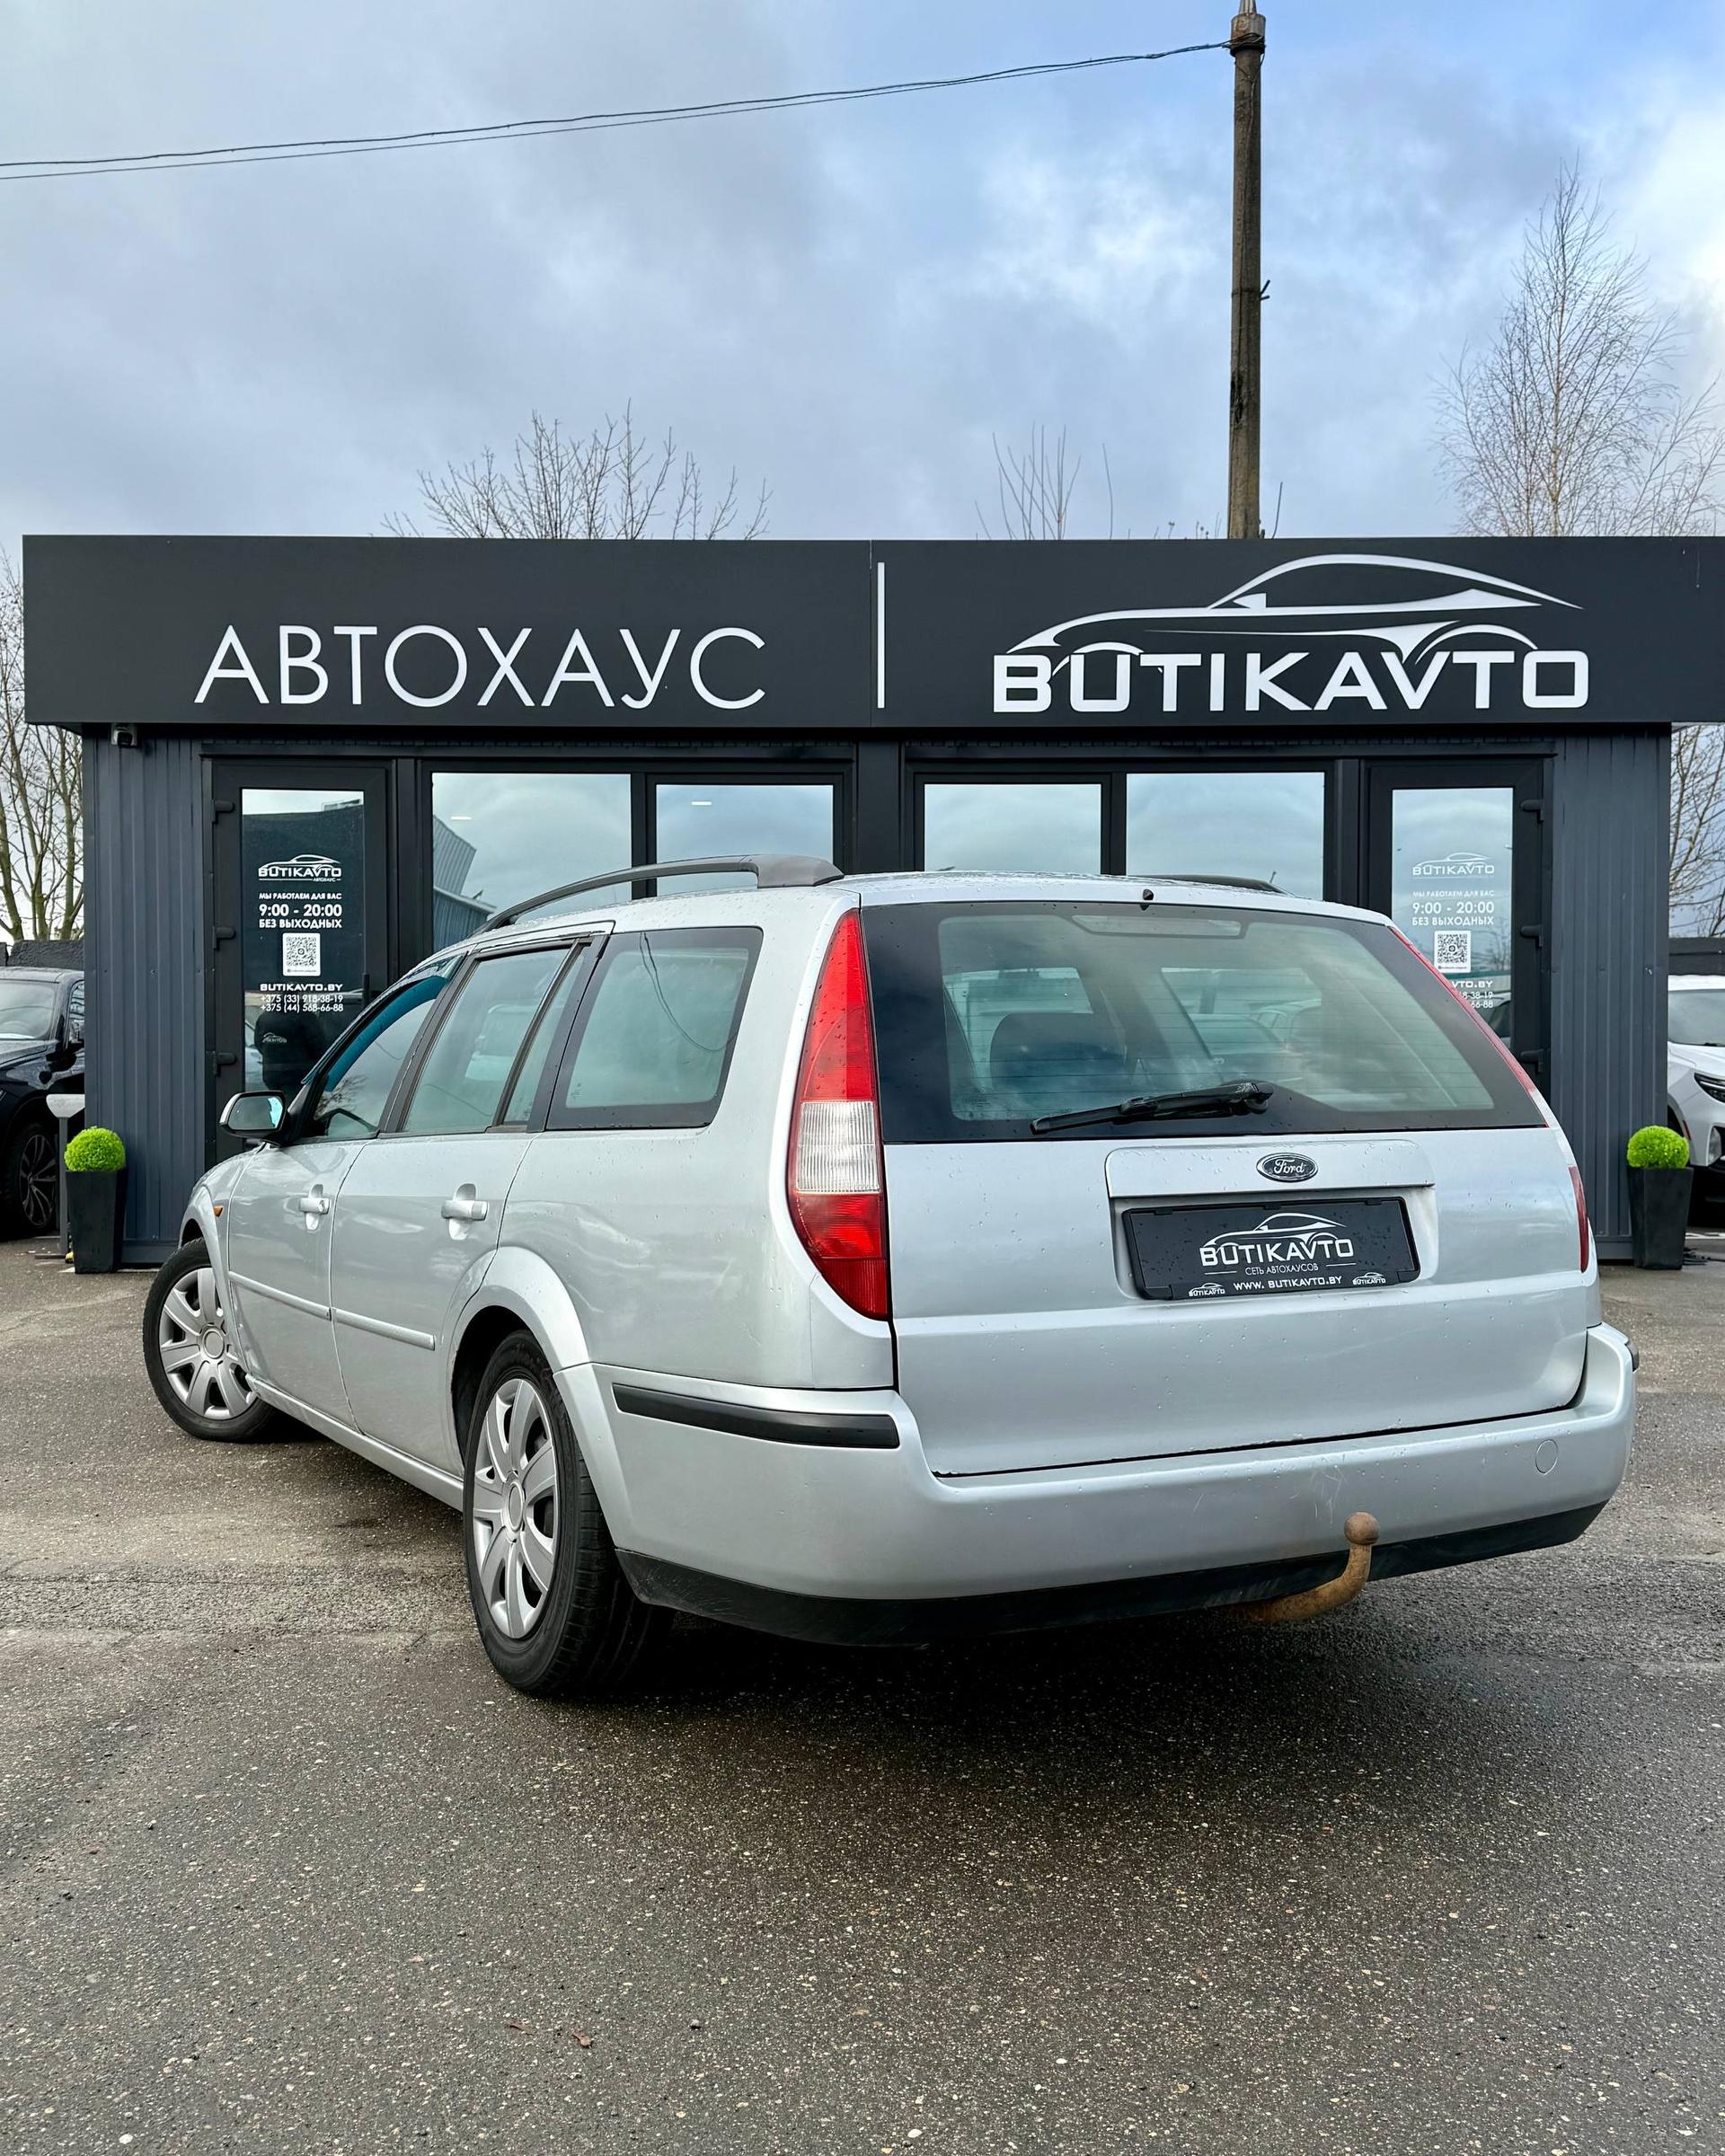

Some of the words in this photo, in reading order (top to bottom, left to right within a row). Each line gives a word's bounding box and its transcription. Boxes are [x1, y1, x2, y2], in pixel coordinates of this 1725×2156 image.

[194, 624, 766, 711] АВТОХАУС
[992, 649, 1589, 713] BUTIKAVTO
[258, 868, 341, 877] BUTIKAVTO
[1412, 865, 1495, 875] BUTIKAVTO
[311, 893, 325, 901] ДЛЯ
[259, 904, 289, 916] 9:00
[303, 904, 342, 916] 20:00
[1412, 902, 1442, 914] 9:00
[1456, 901, 1495, 914] 20:00
[259, 919, 277, 928] БЕЗ
[279, 918, 342, 929] ВЫХОДНЫХ
[1412, 917, 1429, 926] БЕЗ
[1432, 916, 1494, 926] ВЫХОДНЫХ
[284, 994, 300, 1004] (33)
[302, 994, 343, 1003] 918-38-19
[284, 1003, 300, 1013] (44)
[302, 1003, 343, 1012] 568-66-88
[1273, 1159, 1305, 1173] Ford
[1199, 1239, 1355, 1267] BUTIKAVTO
[1244, 1267, 1265, 1276] СЕТЬ
[1266, 1262, 1319, 1274] АВТОХАУСОВ
[1233, 1280, 1264, 1291] WWW.
[1268, 1276, 1343, 1288] BUTIKAVTO.BY
[1352, 1277, 1386, 1286] BUTIKAVTO
[1189, 1288, 1225, 1296] BUTIKAVTO
